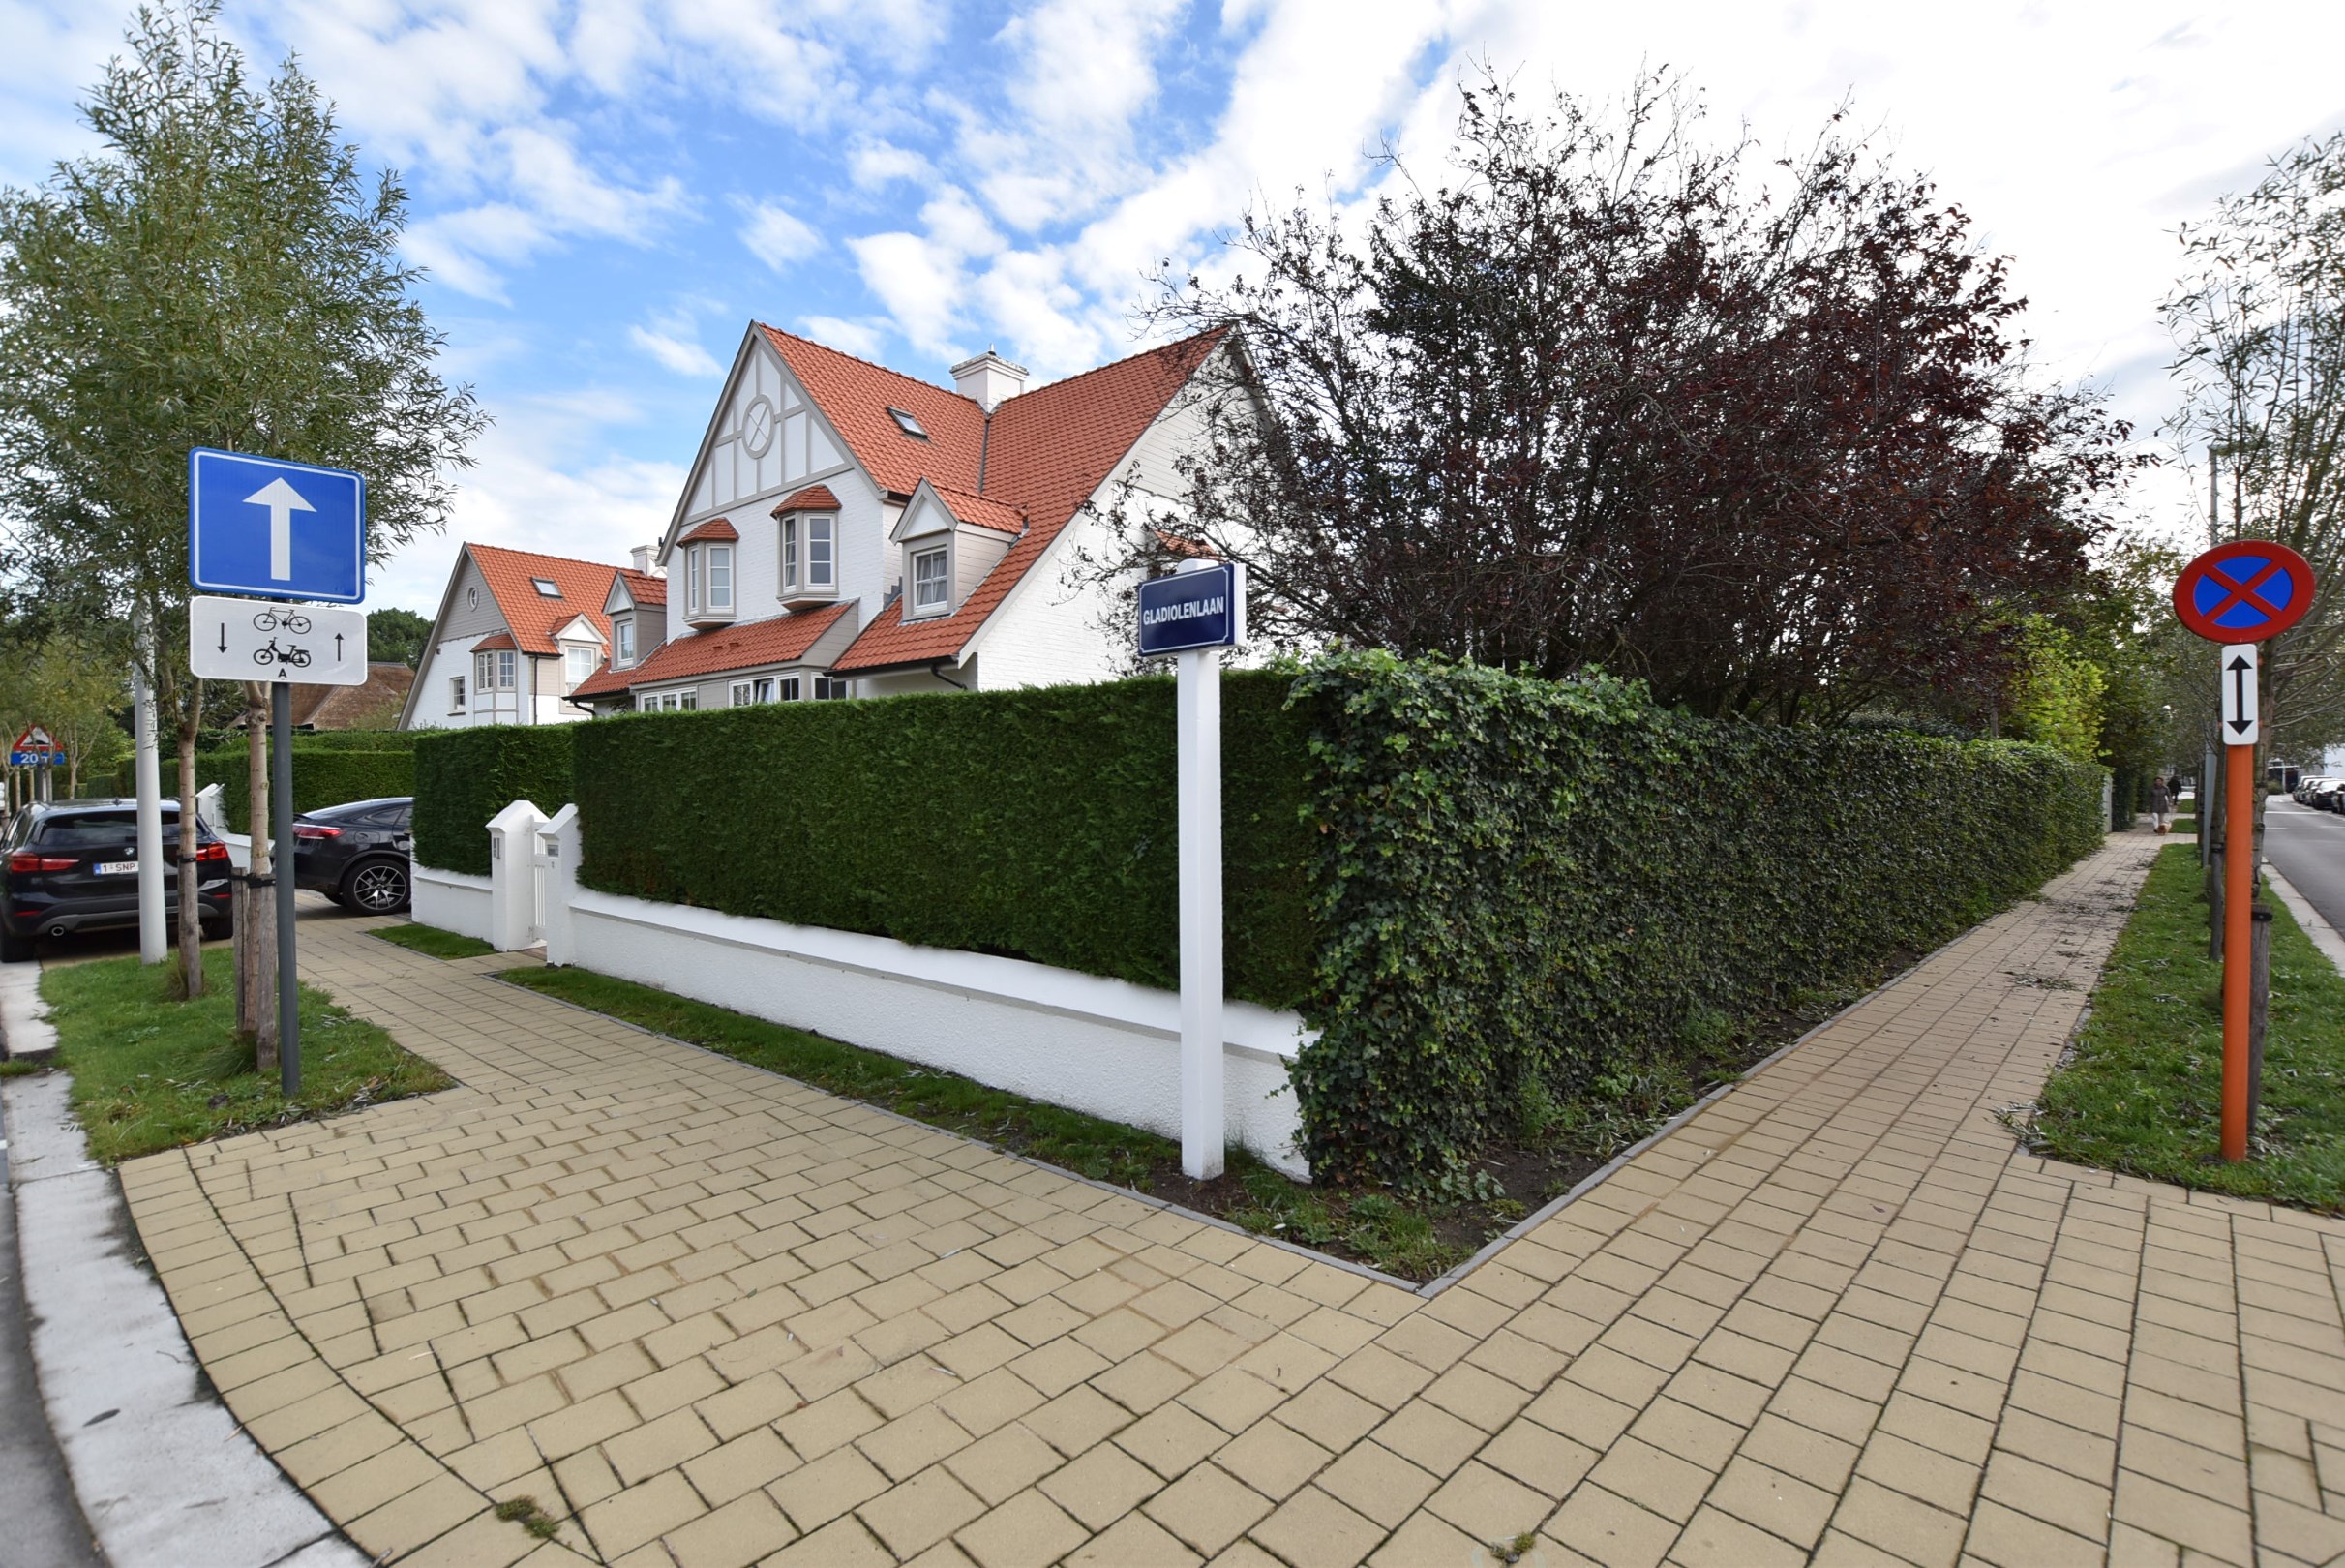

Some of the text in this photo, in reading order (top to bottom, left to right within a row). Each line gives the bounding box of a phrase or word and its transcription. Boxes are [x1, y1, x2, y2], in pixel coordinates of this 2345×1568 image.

[1143, 596, 1223, 625] GLADIOLENLAAN
[278, 667, 287, 678] A
[20, 753, 39, 764] 20
